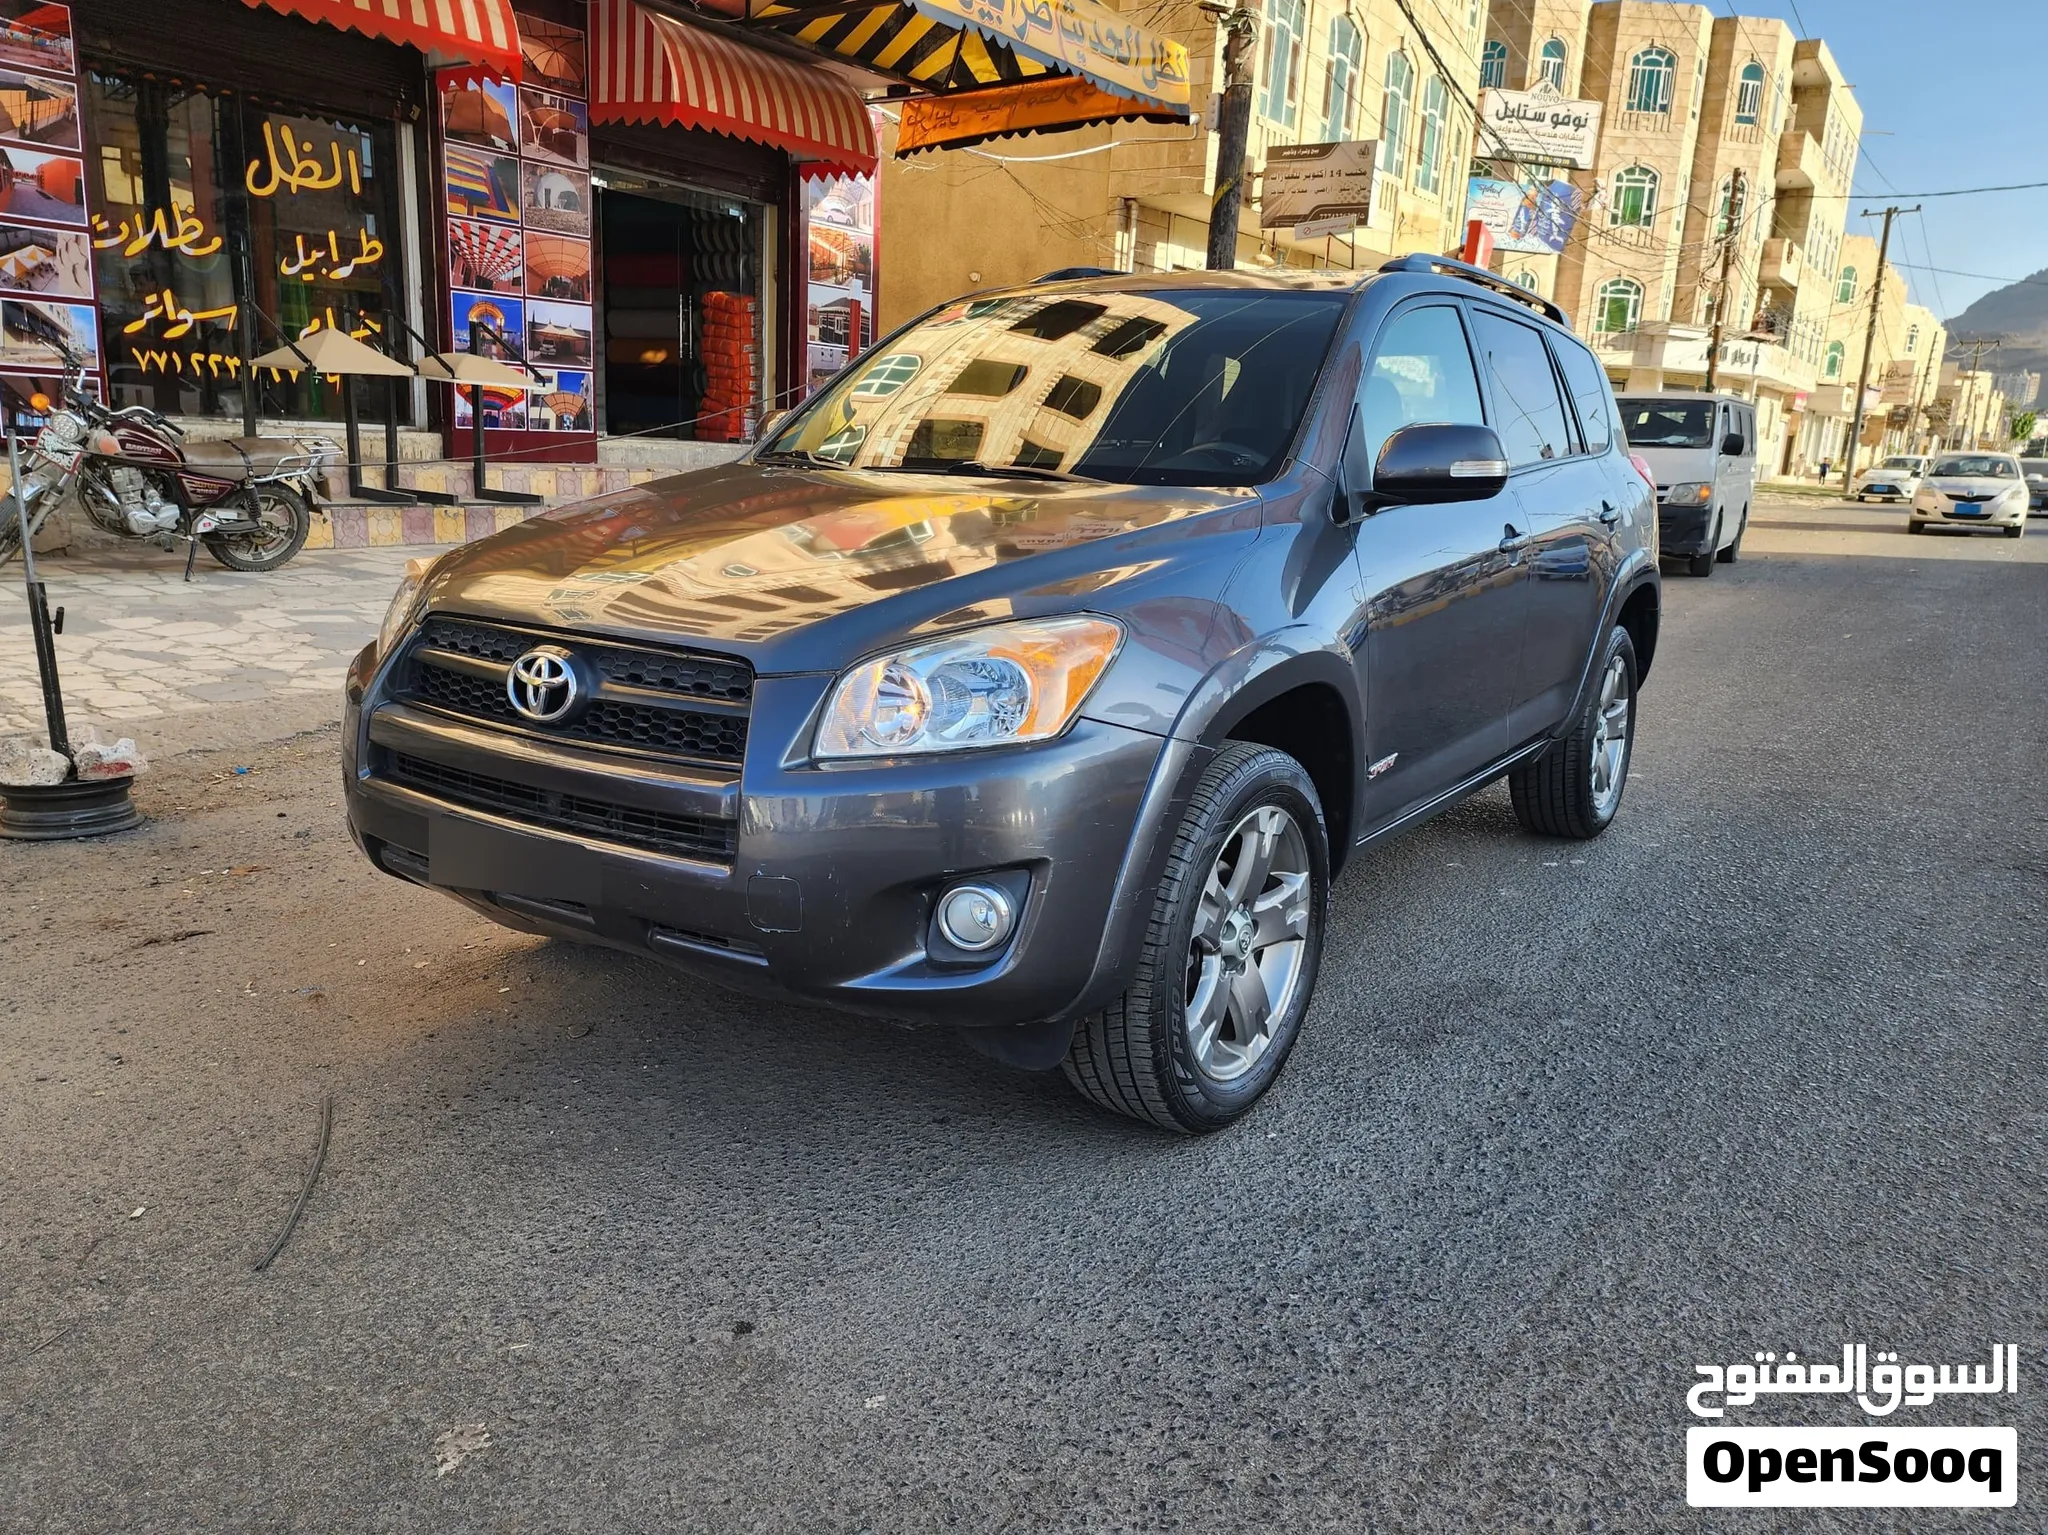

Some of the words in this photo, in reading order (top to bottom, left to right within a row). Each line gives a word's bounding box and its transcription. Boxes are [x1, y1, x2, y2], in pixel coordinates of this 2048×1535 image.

[1495, 101, 1546, 124] ستايل
[1531, 92, 1560, 103] NOUVO
[1550, 108, 1589, 132] نوفو
[245, 120, 361, 197] الظل
[1329, 169, 1341, 178] 14
[91, 201, 222, 257] مظلات
[280, 227, 383, 281] طرابيل
[123, 288, 238, 339] سواتر
